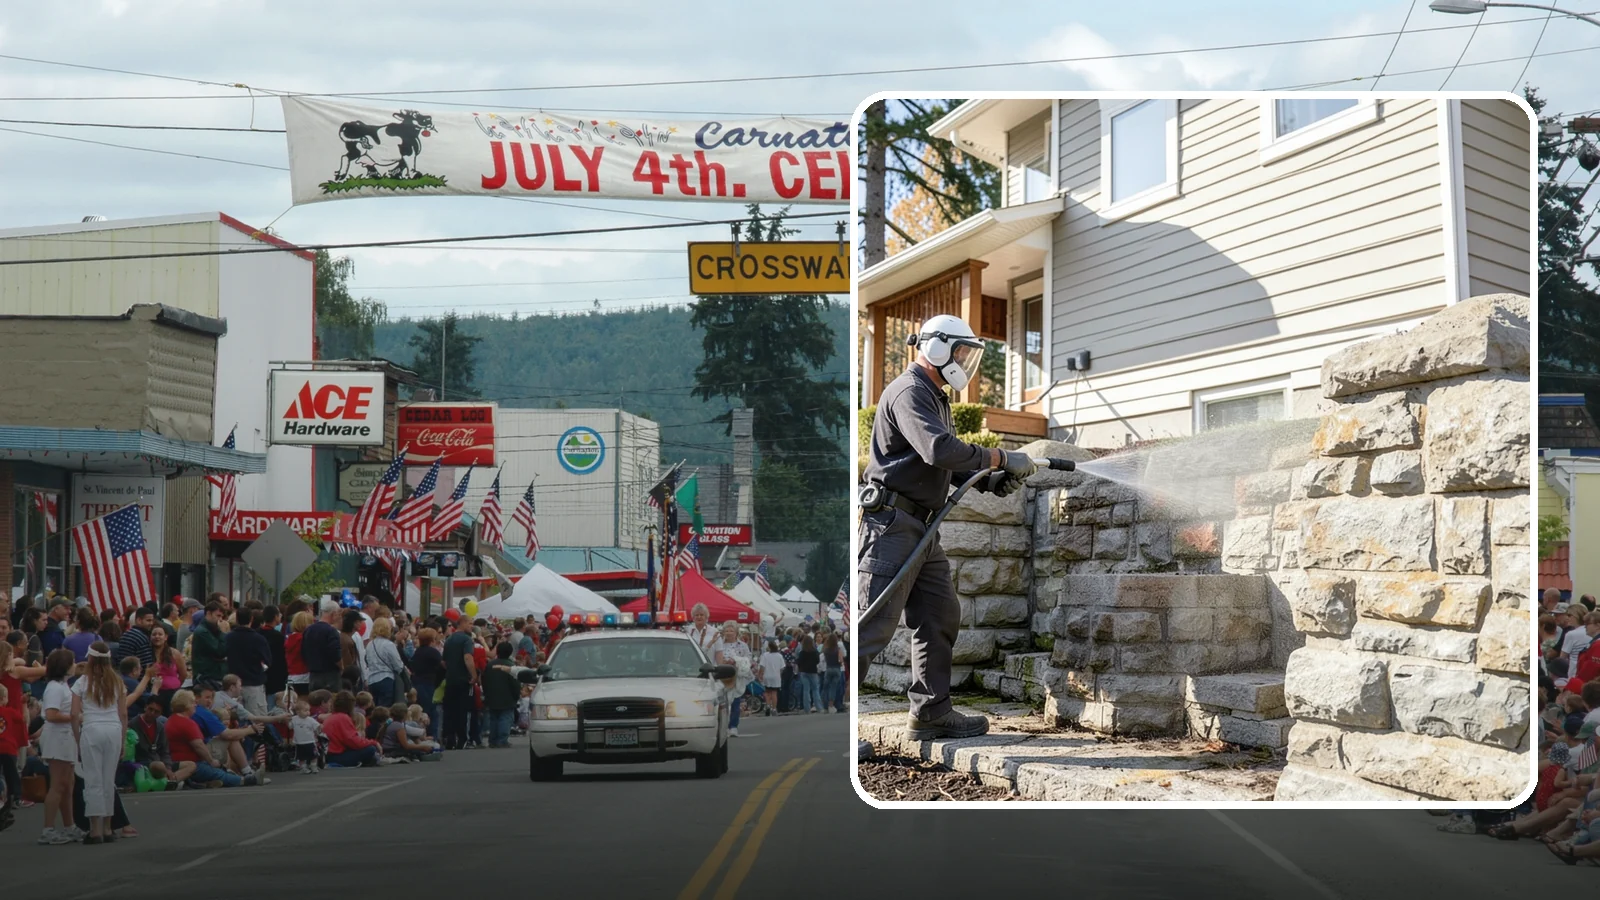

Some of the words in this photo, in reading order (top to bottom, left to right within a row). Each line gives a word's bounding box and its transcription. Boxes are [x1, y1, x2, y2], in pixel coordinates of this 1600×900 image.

[481, 140, 605, 193] JULY
[632, 149, 747, 198] 4th.
[697, 254, 850, 280] CROSSWA
[282, 379, 374, 420] ACE
[406, 410, 453, 422] CEDAR
[461, 410, 485, 422] LOG
[283, 420, 371, 437] Hardware
[95, 485, 124, 495] Vincent
[126, 486, 136, 495] de
[138, 486, 155, 496] Paul
[81, 503, 154, 522] THT
[212, 515, 331, 536] HARDARE
[688, 526, 741, 535] CRNATION
[699, 535, 730, 543] GLASS
